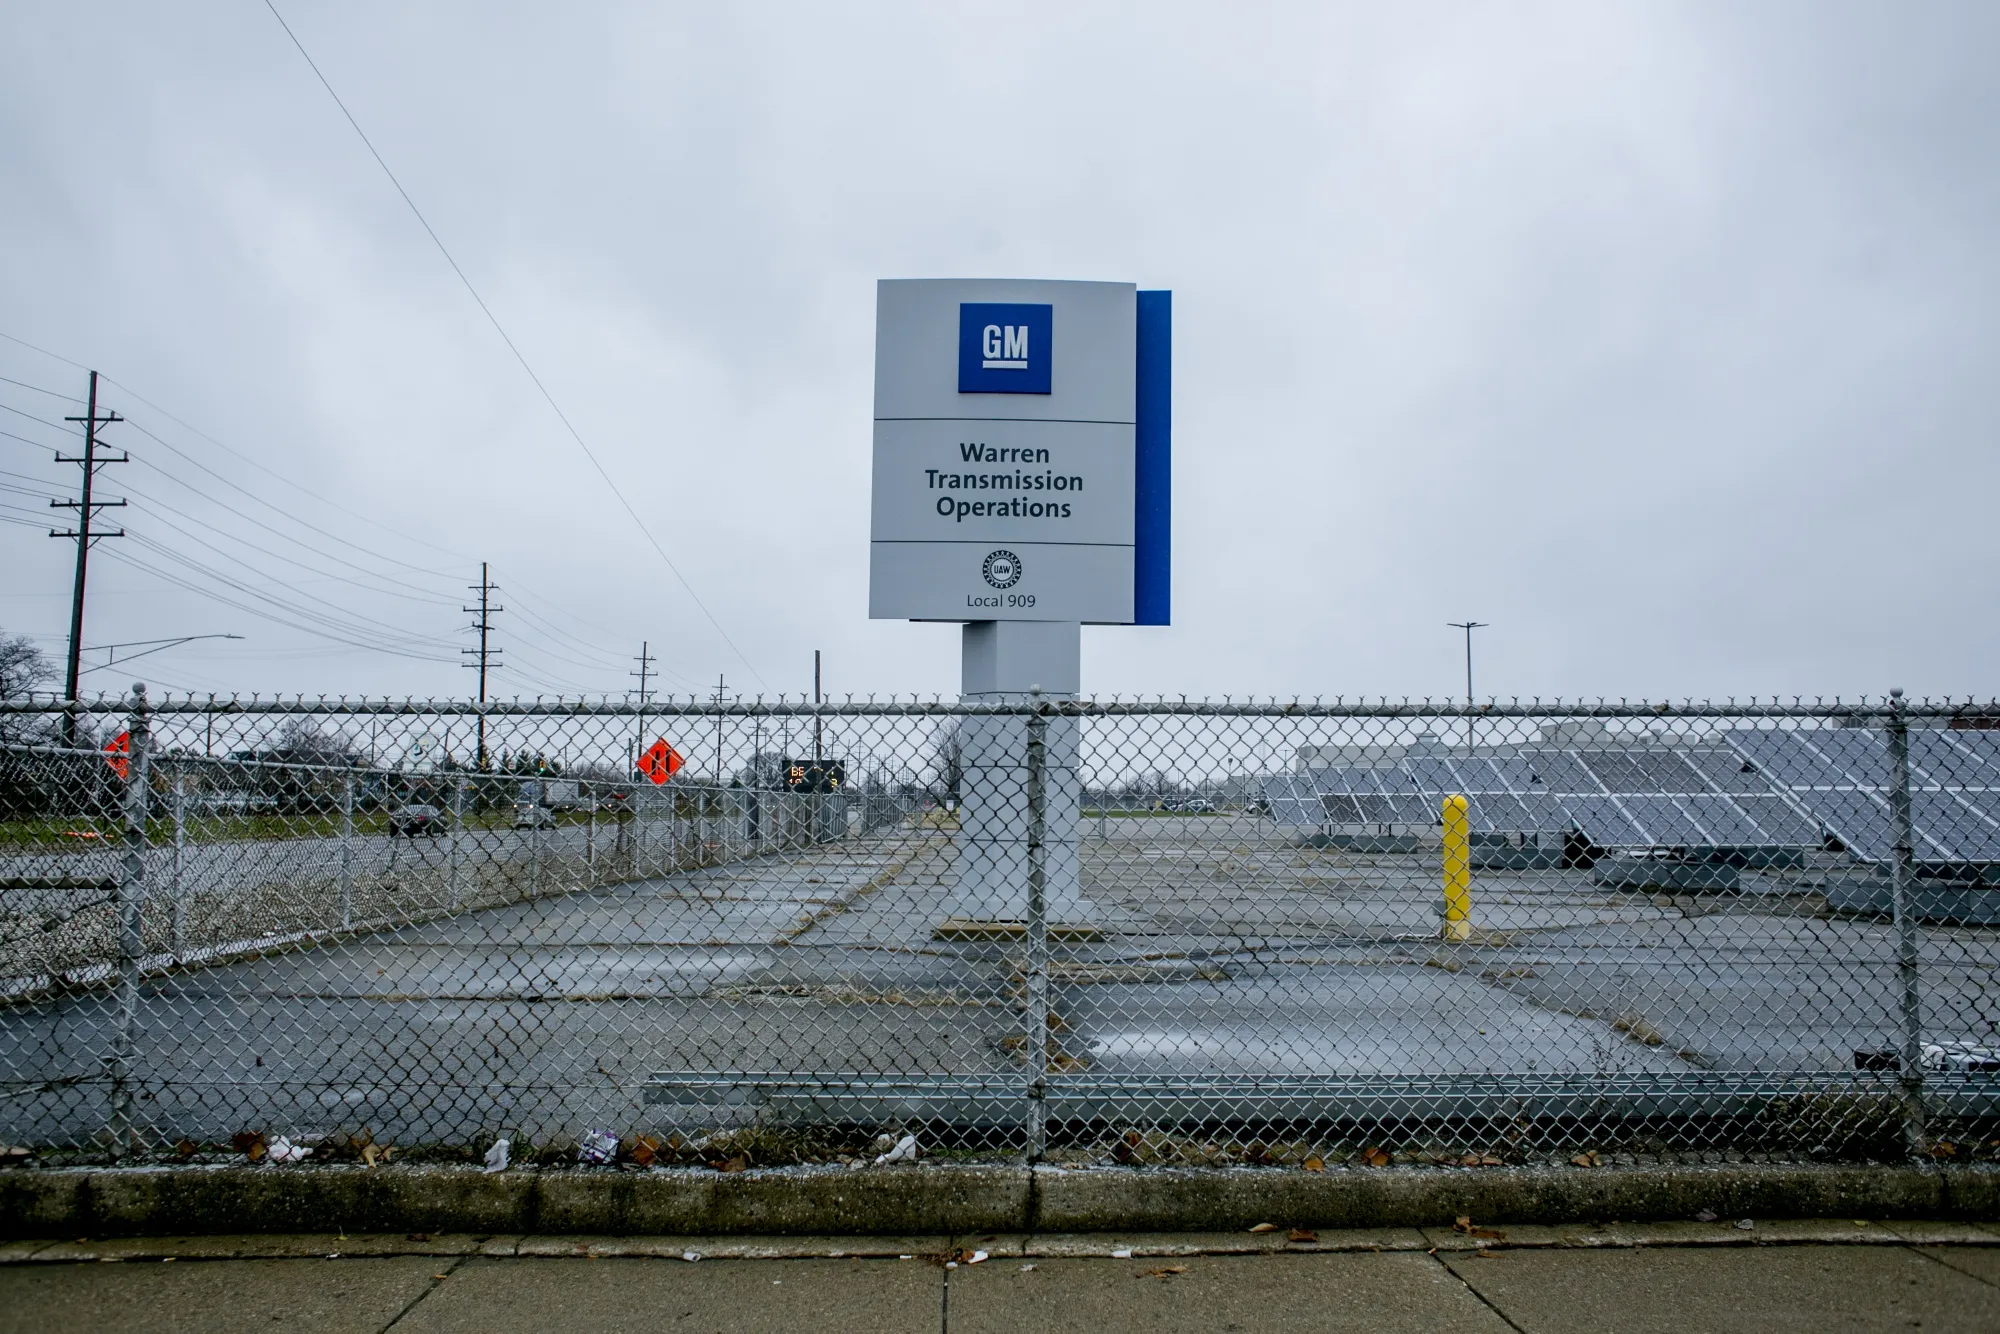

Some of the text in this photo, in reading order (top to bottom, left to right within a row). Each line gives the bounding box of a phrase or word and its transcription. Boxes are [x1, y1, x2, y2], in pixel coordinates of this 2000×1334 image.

[982, 324, 1028, 359] GM
[960, 443, 1050, 463] Warren
[925, 469, 1083, 491] Transmission
[936, 496, 1071, 522] Operations
[993, 565, 1011, 574] UAW
[967, 594, 1036, 608] Local 909
